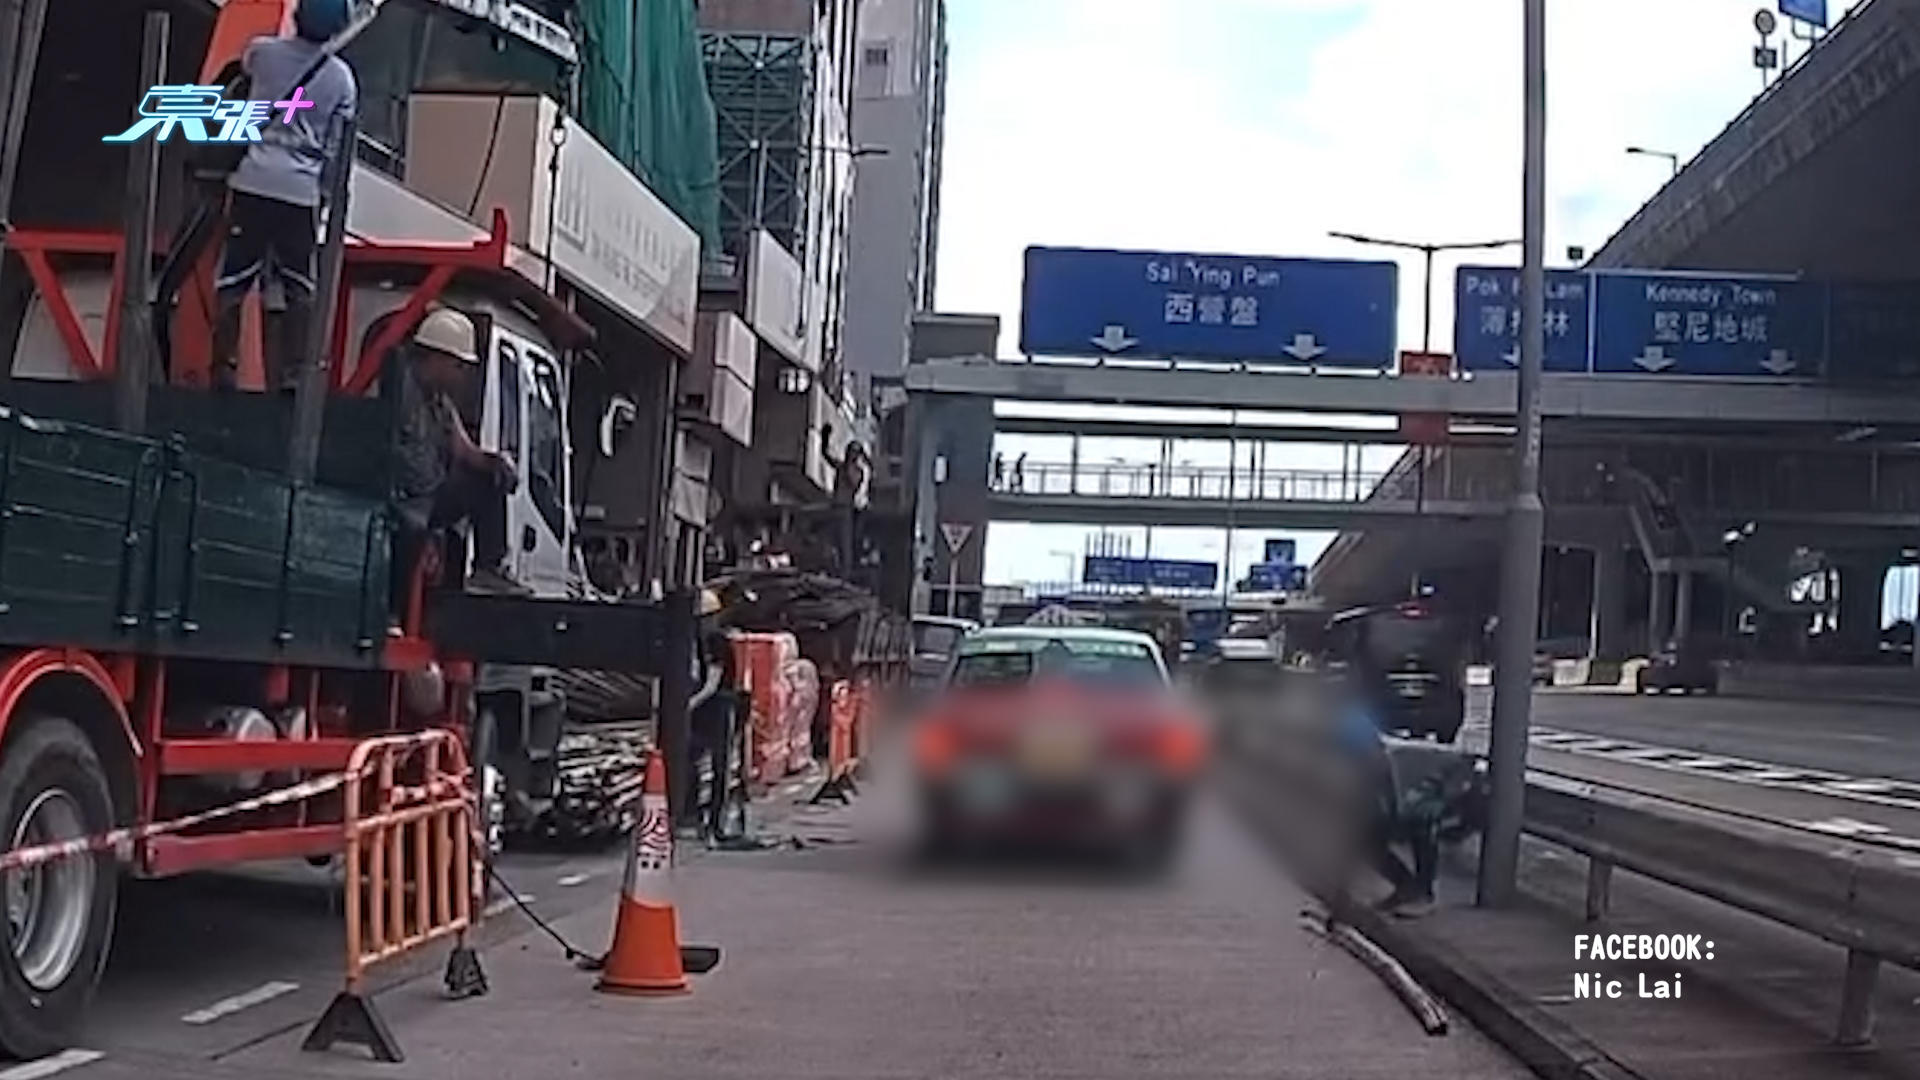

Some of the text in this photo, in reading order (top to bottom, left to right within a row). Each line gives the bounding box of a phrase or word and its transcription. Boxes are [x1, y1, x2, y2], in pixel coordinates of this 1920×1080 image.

[1145, 260, 1280, 291] Sai Ying Pun
[1466, 275, 1500, 296] Pok
[1544, 280, 1584, 300] Lam
[1164, 293, 1258, 326] 西營盤
[1645, 282, 1777, 308] Kennedy Town
[1654, 311, 1768, 343] 堅尼地城
